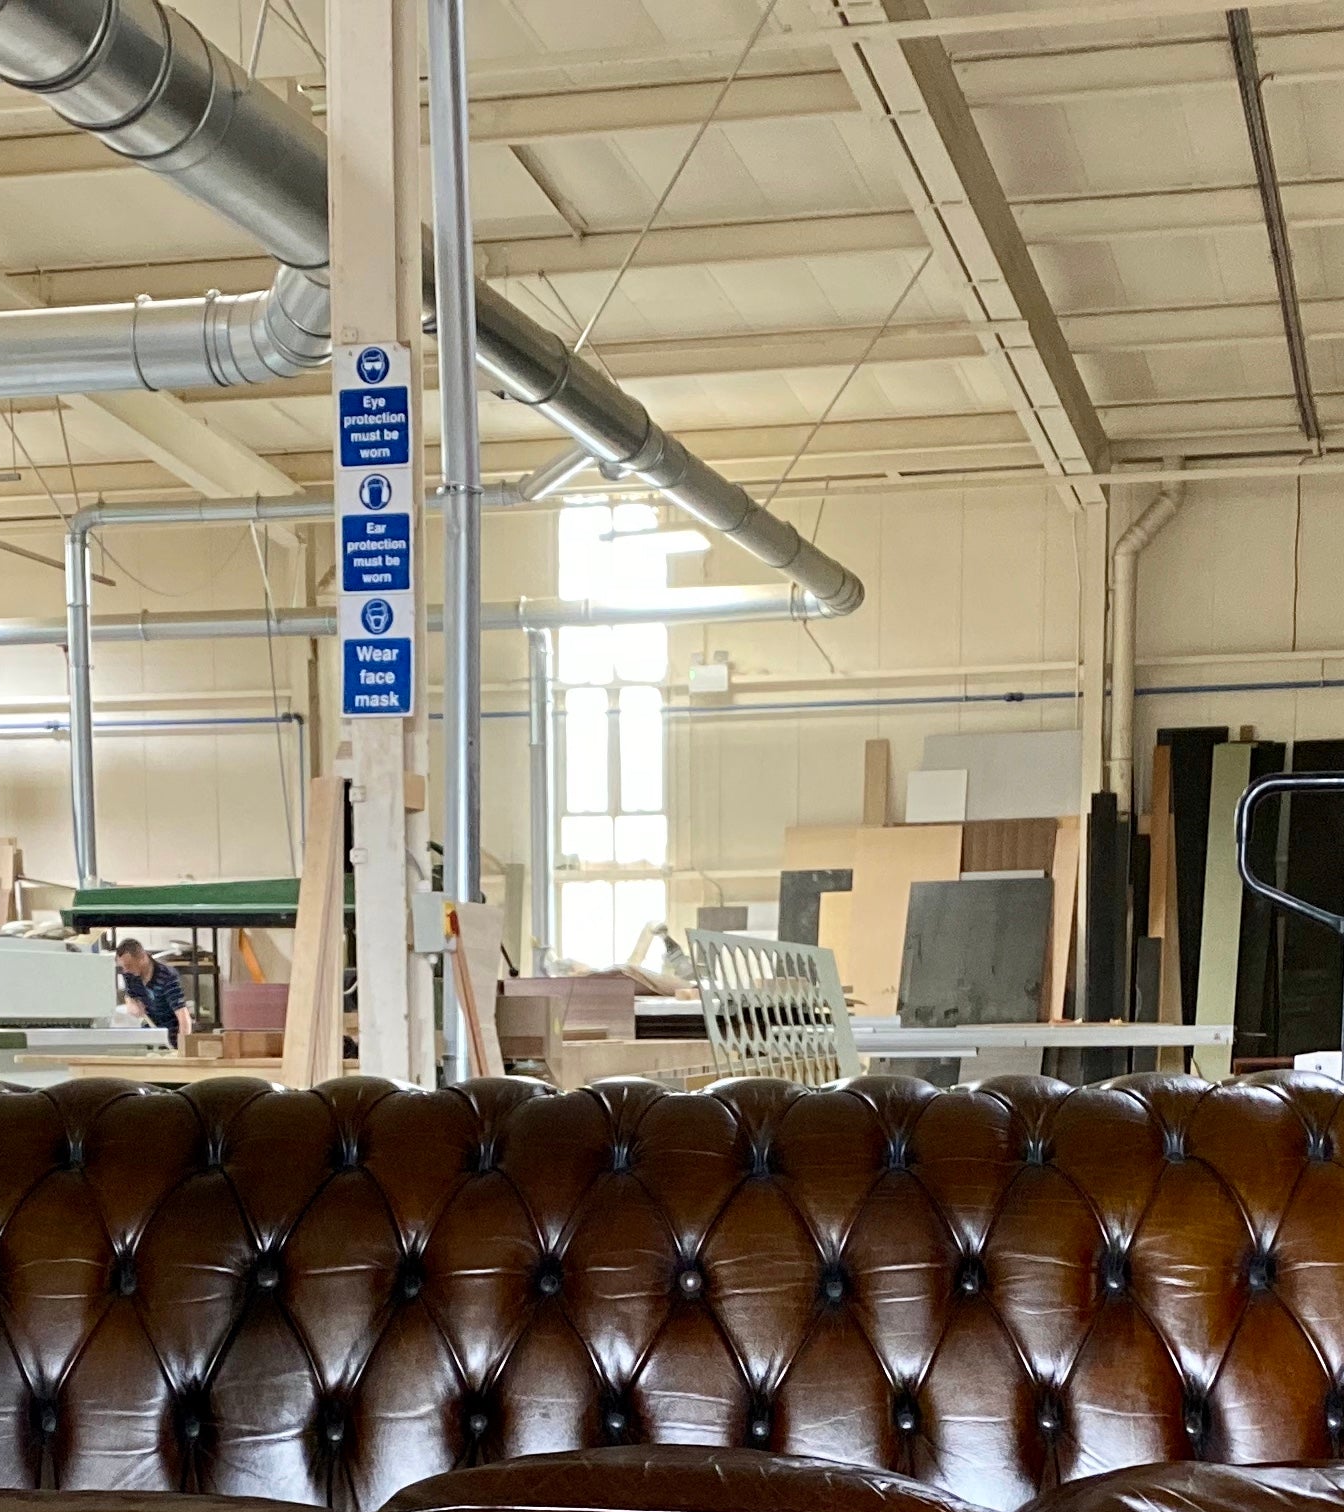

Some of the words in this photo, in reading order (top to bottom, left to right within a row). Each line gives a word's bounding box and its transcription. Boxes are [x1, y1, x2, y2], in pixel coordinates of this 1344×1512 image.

[363, 395, 386, 410] Eye
[344, 411, 406, 429] protection
[350, 429, 381, 443] must
[383, 428, 400, 441] be
[359, 447, 391, 459] worn
[366, 521, 387, 535] Ear
[346, 538, 406, 554] protection
[353, 555, 383, 568] must
[384, 554, 401, 567] be
[361, 573, 392, 583] worn
[356, 645, 399, 662] Wear
[359, 669, 396, 685] face
[354, 690, 400, 708] mask
